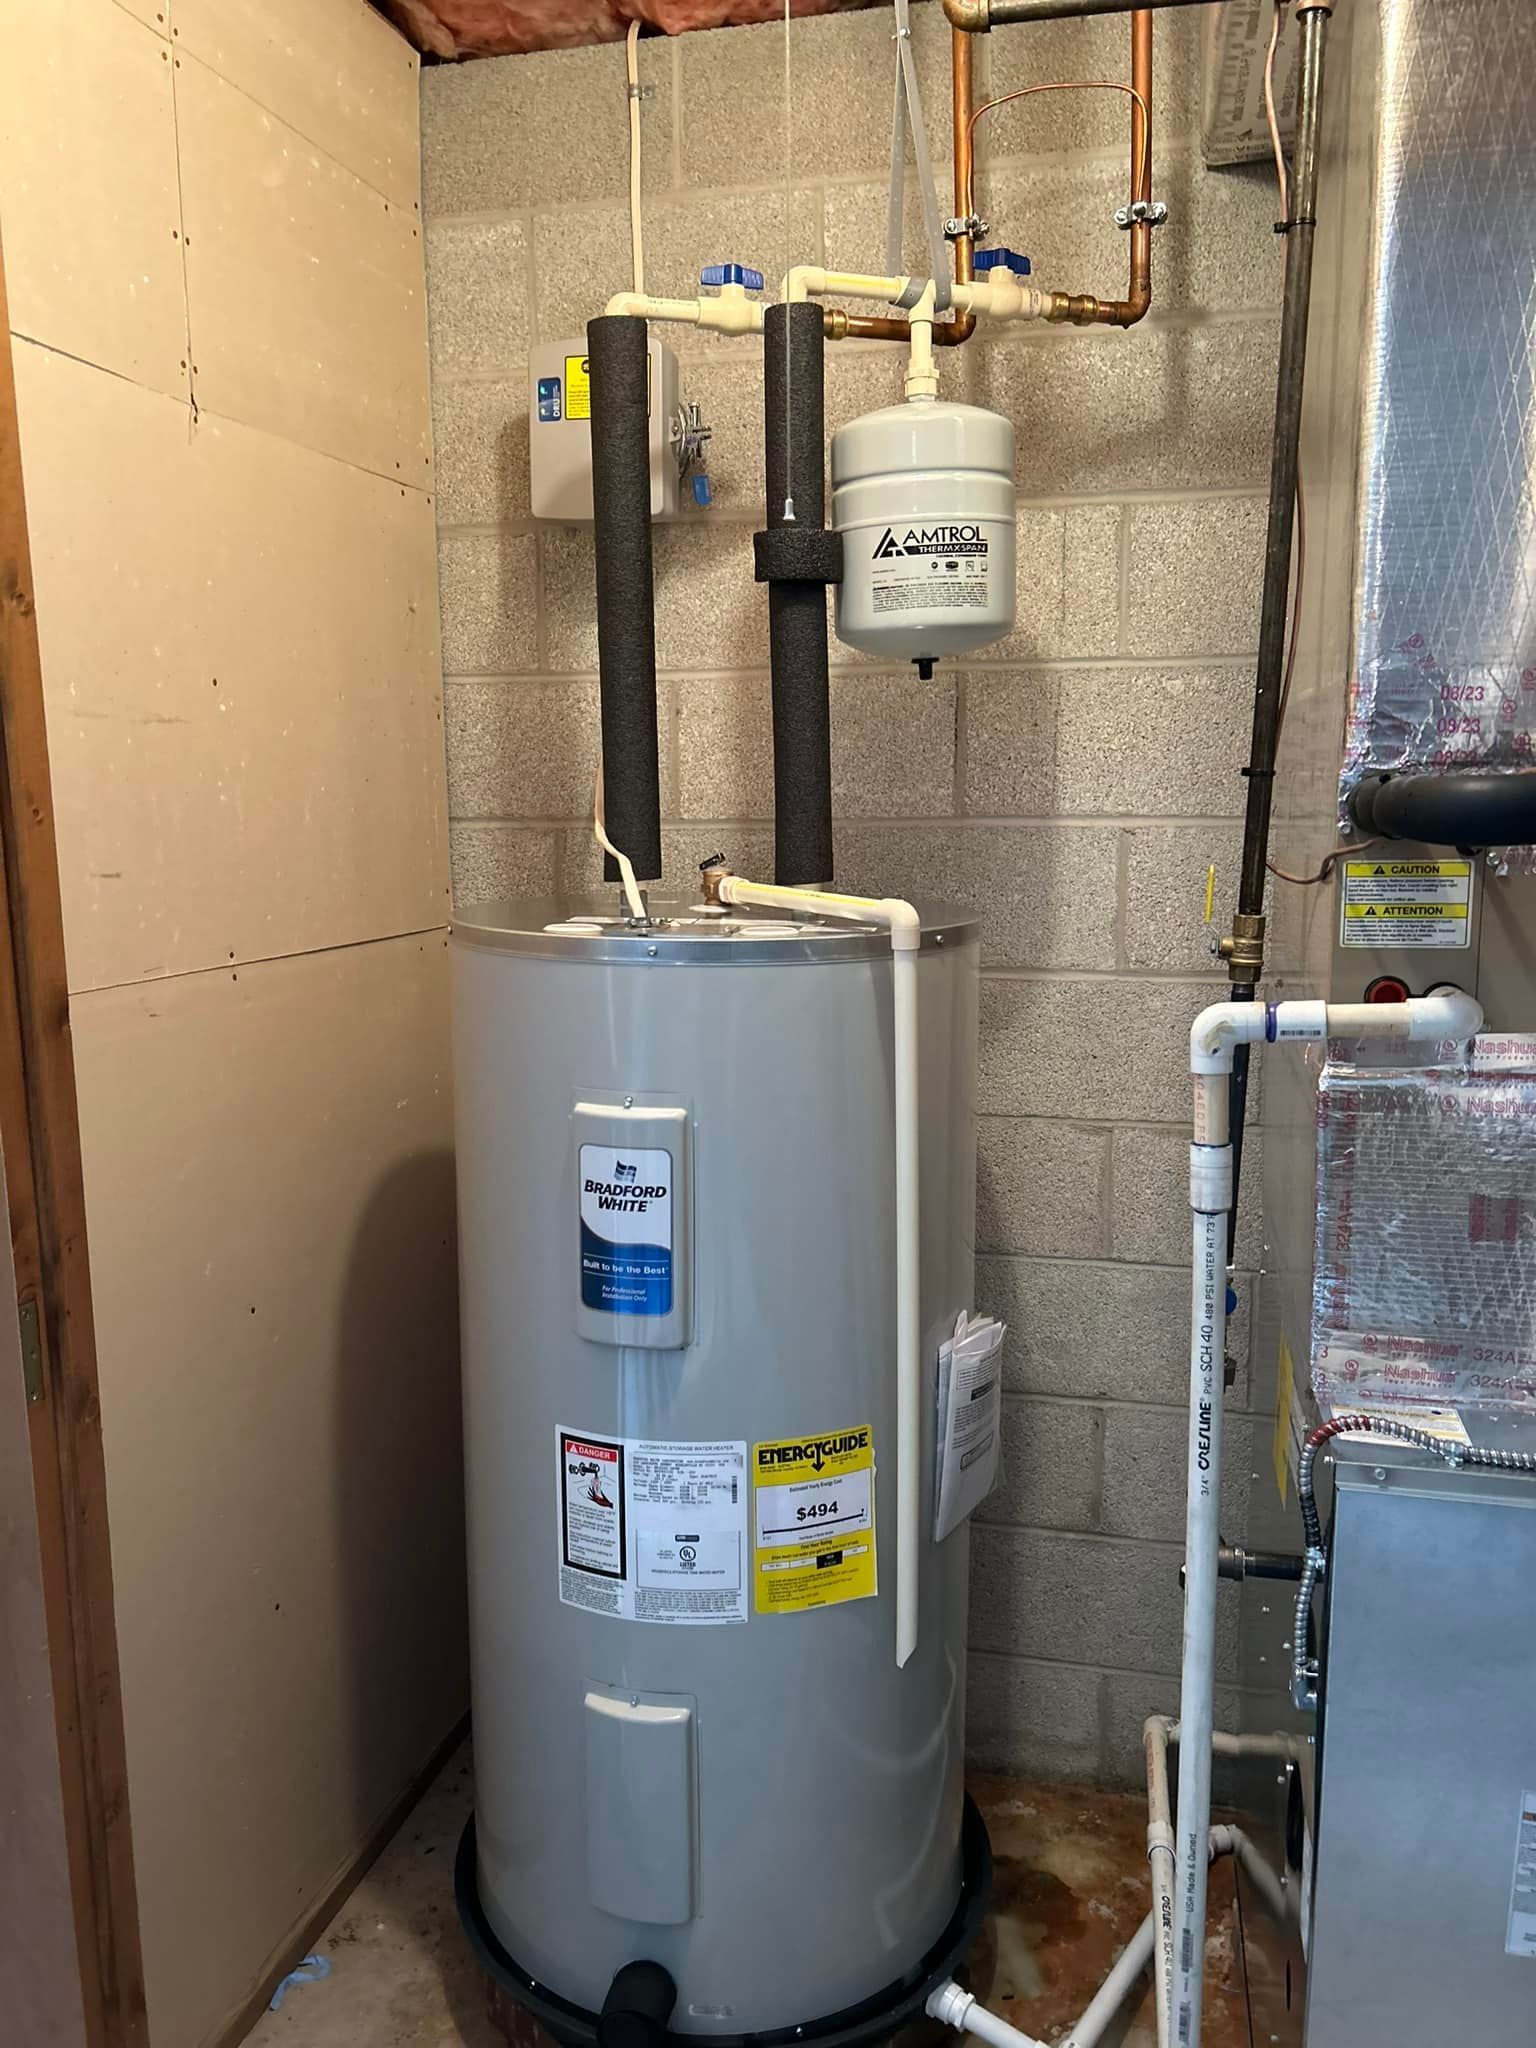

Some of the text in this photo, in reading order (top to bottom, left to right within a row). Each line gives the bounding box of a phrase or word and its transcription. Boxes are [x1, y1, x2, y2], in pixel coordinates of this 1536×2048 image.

[903, 526, 988, 545] AMTROL
[1391, 865, 1440, 875] CAUTION
[1383, 906, 1443, 916] ATTENTION
[584, 1179, 667, 1198] BRADFORD
[598, 1196, 648, 1212] WHITE
[1207, 1237, 1215, 1249] AT
[584, 1259, 666, 1275] Built to be the Best
[1206, 1251, 1215, 1281] WATER
[1205, 1284, 1214, 1300] PSI
[1204, 1303, 1214, 1320] 480
[1200, 1325, 1214, 1344] 40
[1200, 1347, 1214, 1372] SCH
[1472, 1348, 1516, 1365] 324A
[1203, 1376, 1213, 1395] PVC
[1470, 1374, 1513, 1390] 324A
[1198, 1403, 1212, 1471] CRESLINE
[578, 1446, 611, 1460] DANGER
[758, 1431, 868, 1468] ENERGYGUIDE
[796, 1500, 840, 1523] $494
[1186, 1833, 1198, 1913] USA Made & Owned
